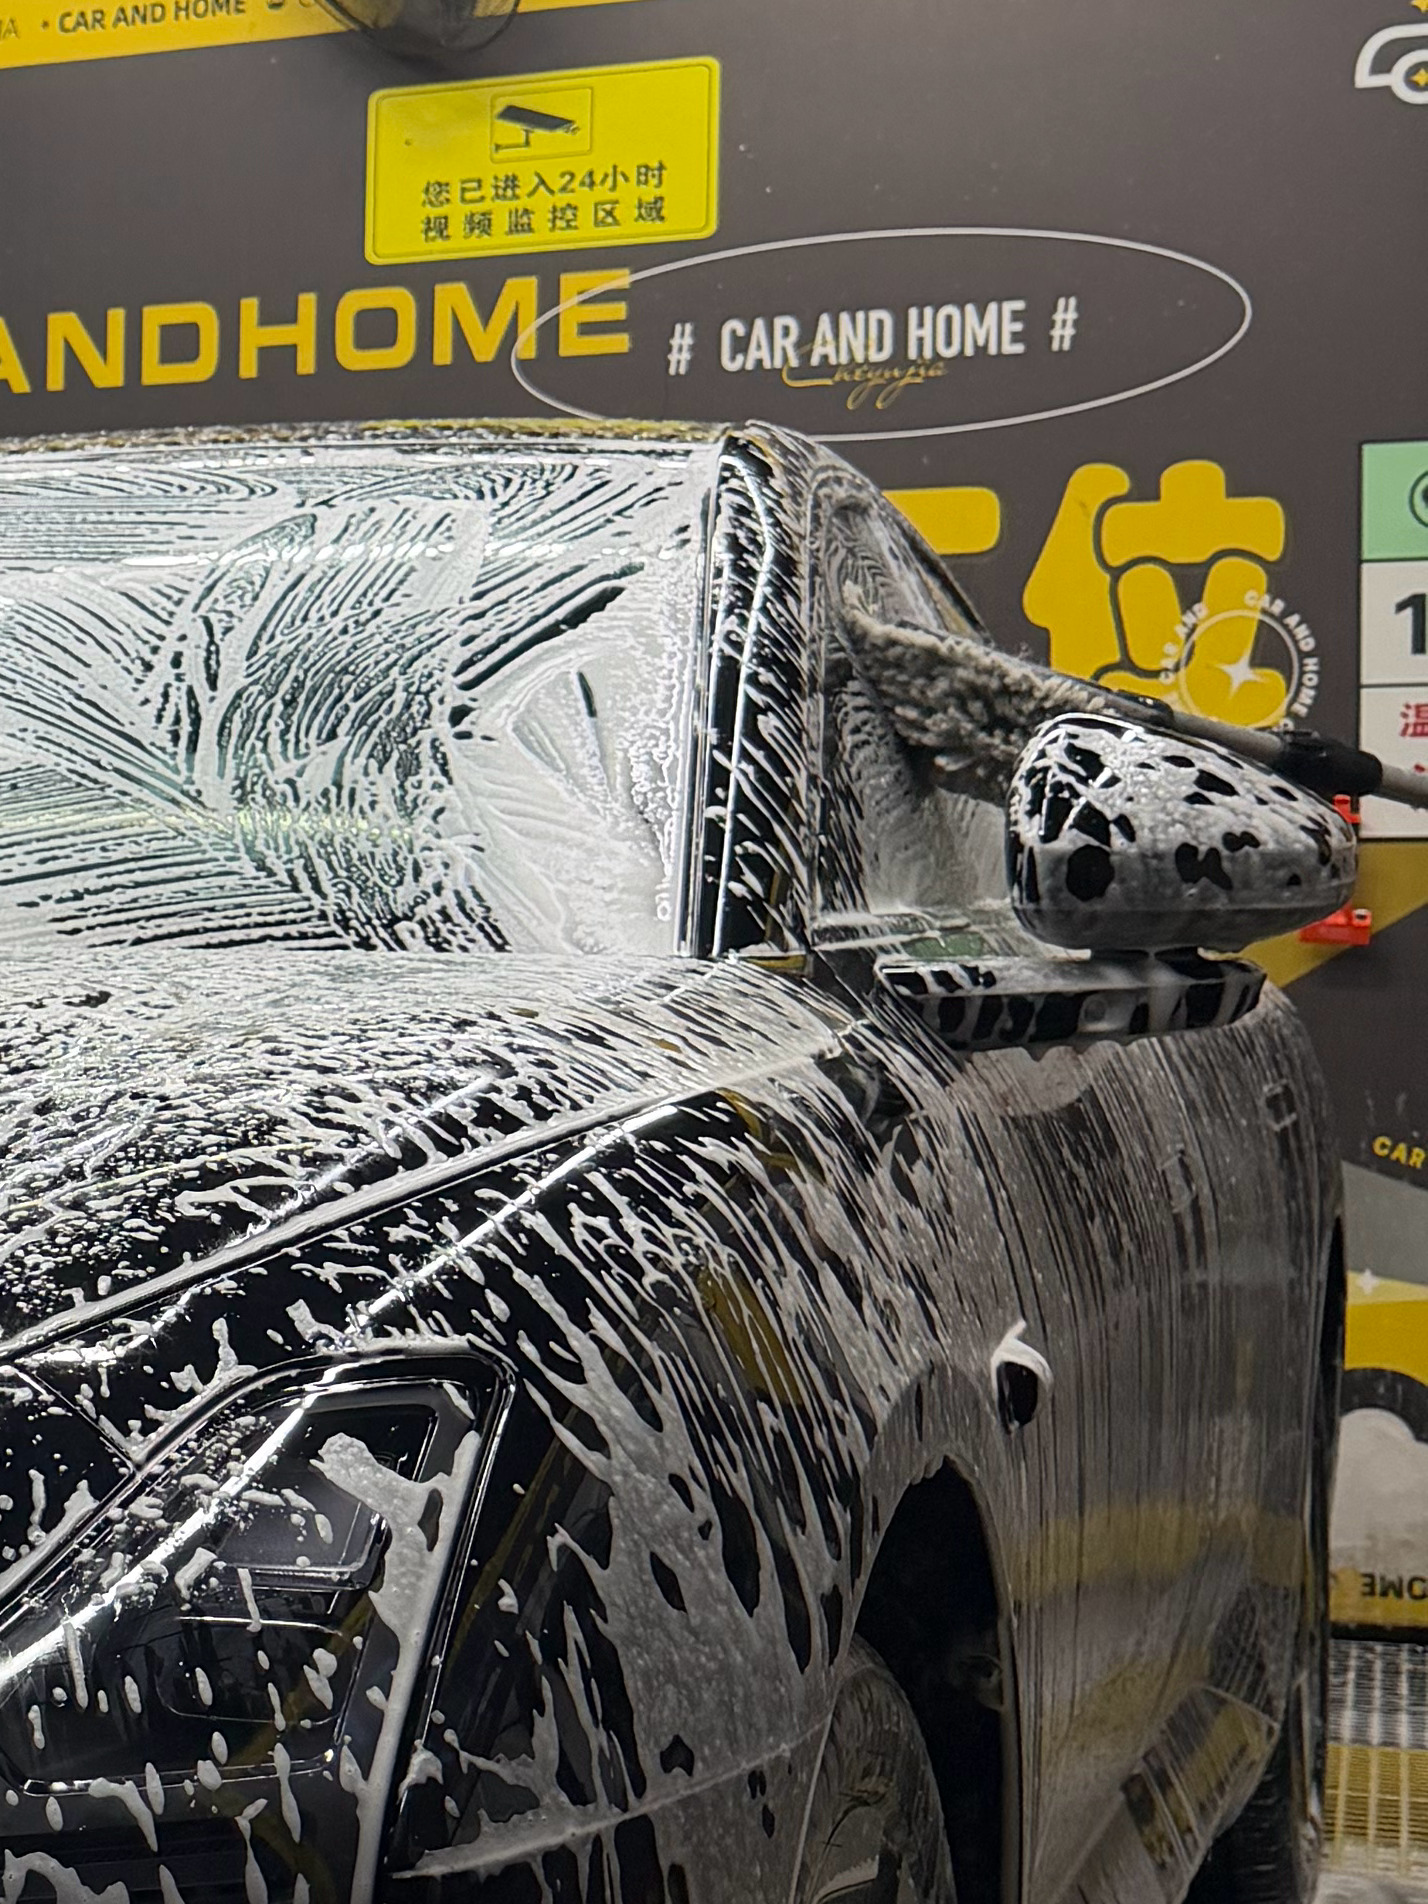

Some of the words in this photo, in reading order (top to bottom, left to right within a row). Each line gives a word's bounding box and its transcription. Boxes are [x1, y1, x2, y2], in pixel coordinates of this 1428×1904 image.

[58, 7, 105, 34] CAR
[112, 2, 167, 30] AND
[421, 160, 667, 209] 您已进入24小时
[422, 197, 666, 243] 视频监控区域
[720, 315, 800, 372] CAR
[810, 308, 894, 366] AND
[907, 299, 1026, 361] HOME
[1282, 613, 1316, 652] AND
[1290, 657, 1320, 717] HOME
[1372, 1134, 1428, 1170] CAR
